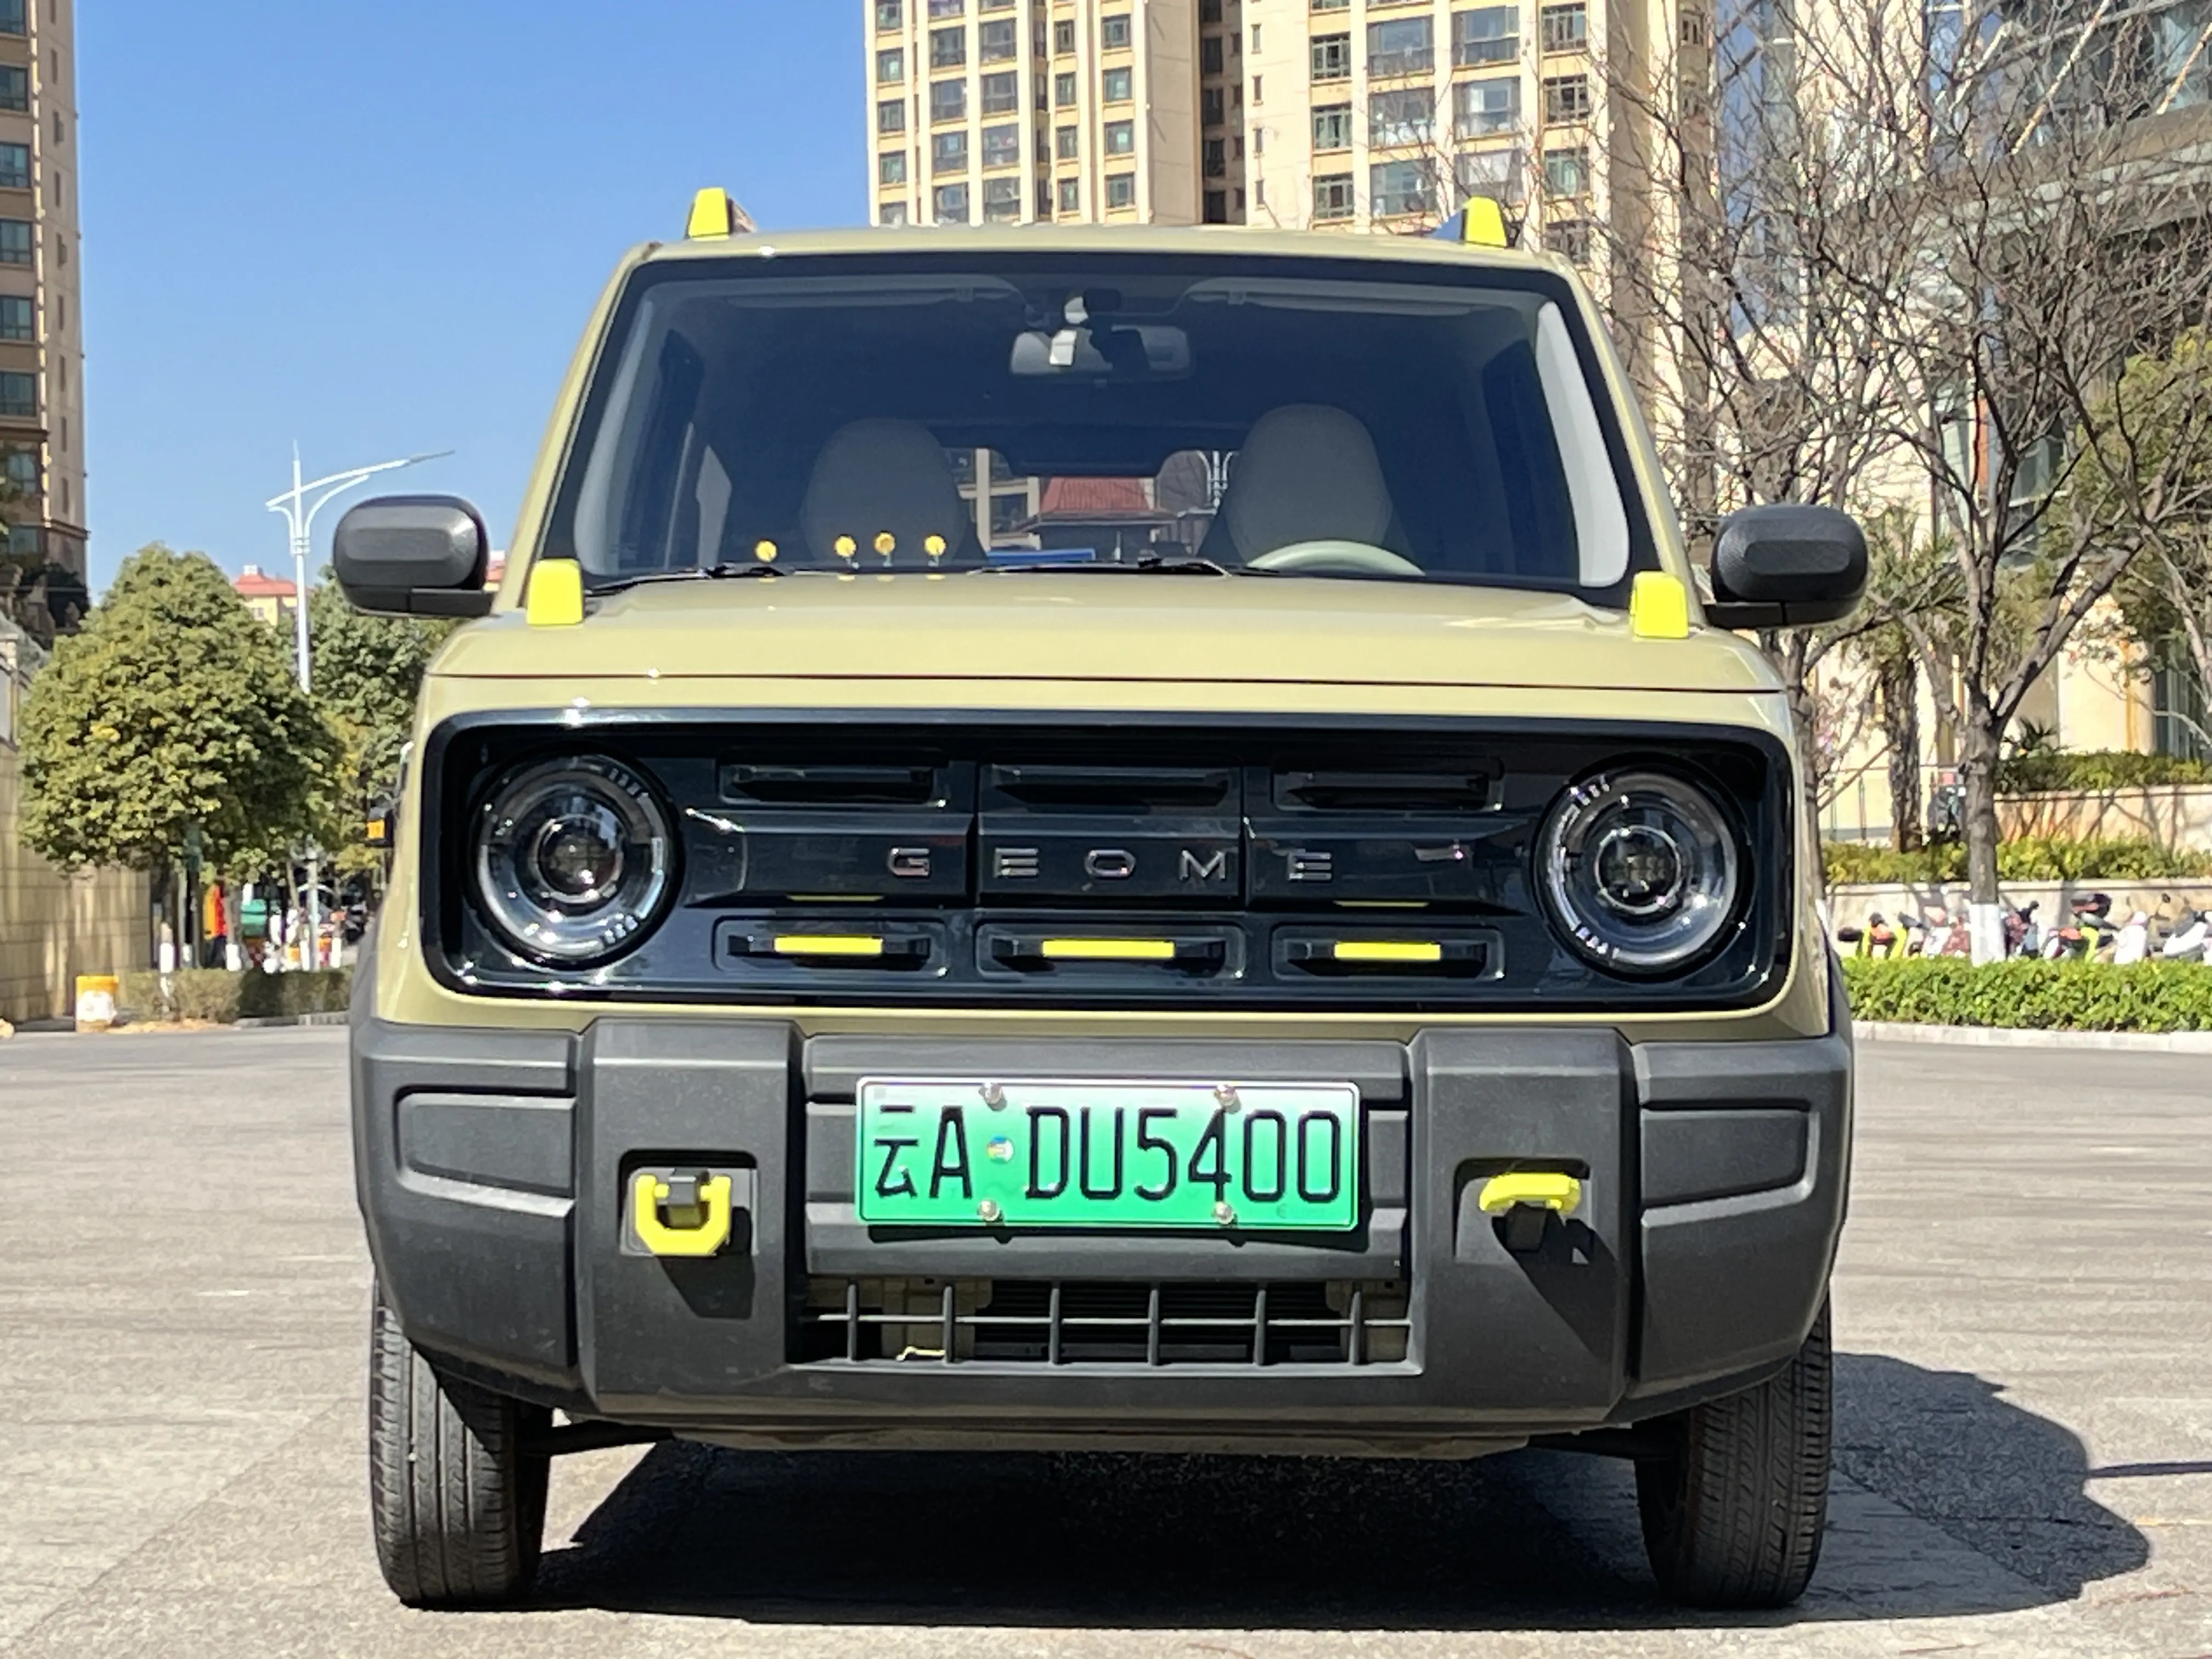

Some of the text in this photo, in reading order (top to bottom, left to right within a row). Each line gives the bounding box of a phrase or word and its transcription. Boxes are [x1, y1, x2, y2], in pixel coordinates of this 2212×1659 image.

[887, 847, 1333, 881] GEOME
[874, 1104, 1341, 1204] 云A DU5400
